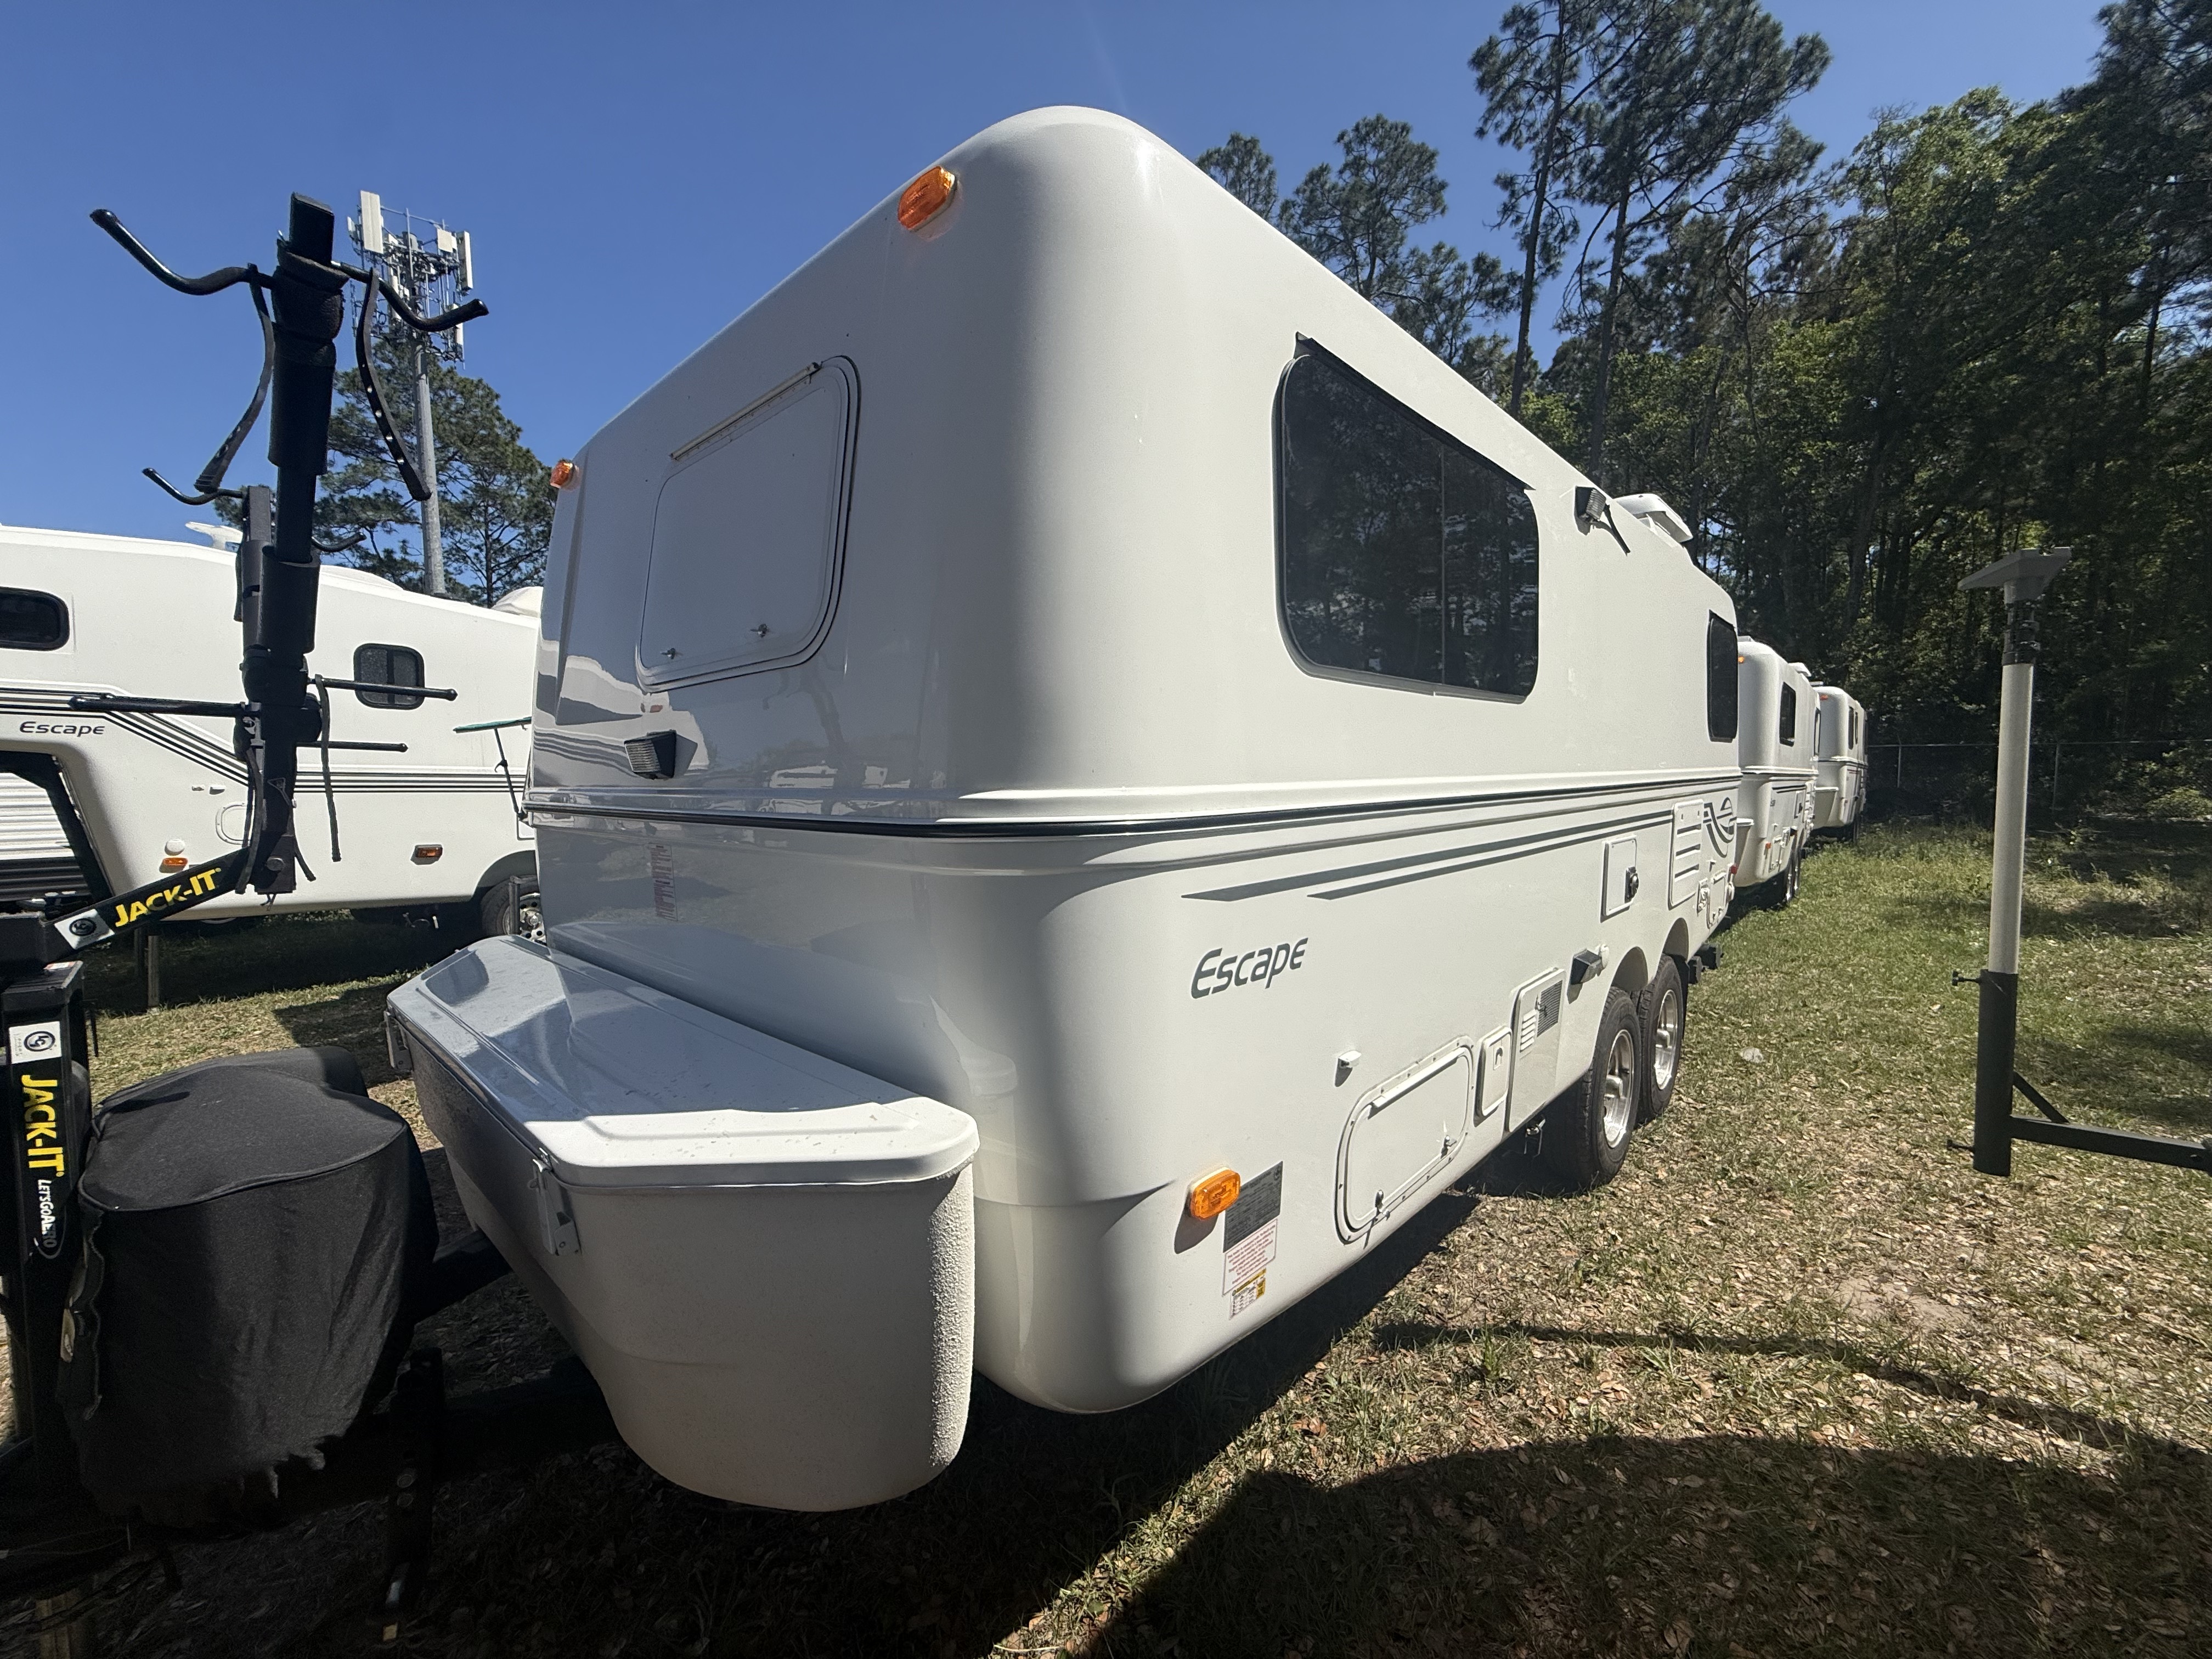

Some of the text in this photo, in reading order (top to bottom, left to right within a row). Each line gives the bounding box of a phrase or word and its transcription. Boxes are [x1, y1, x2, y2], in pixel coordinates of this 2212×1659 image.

[20, 721, 105, 737] Escape
[115, 868, 216, 928] JACK-IT
[1191, 937, 1308, 999] Escape
[21, 1074, 65, 1171] JACK-IT
